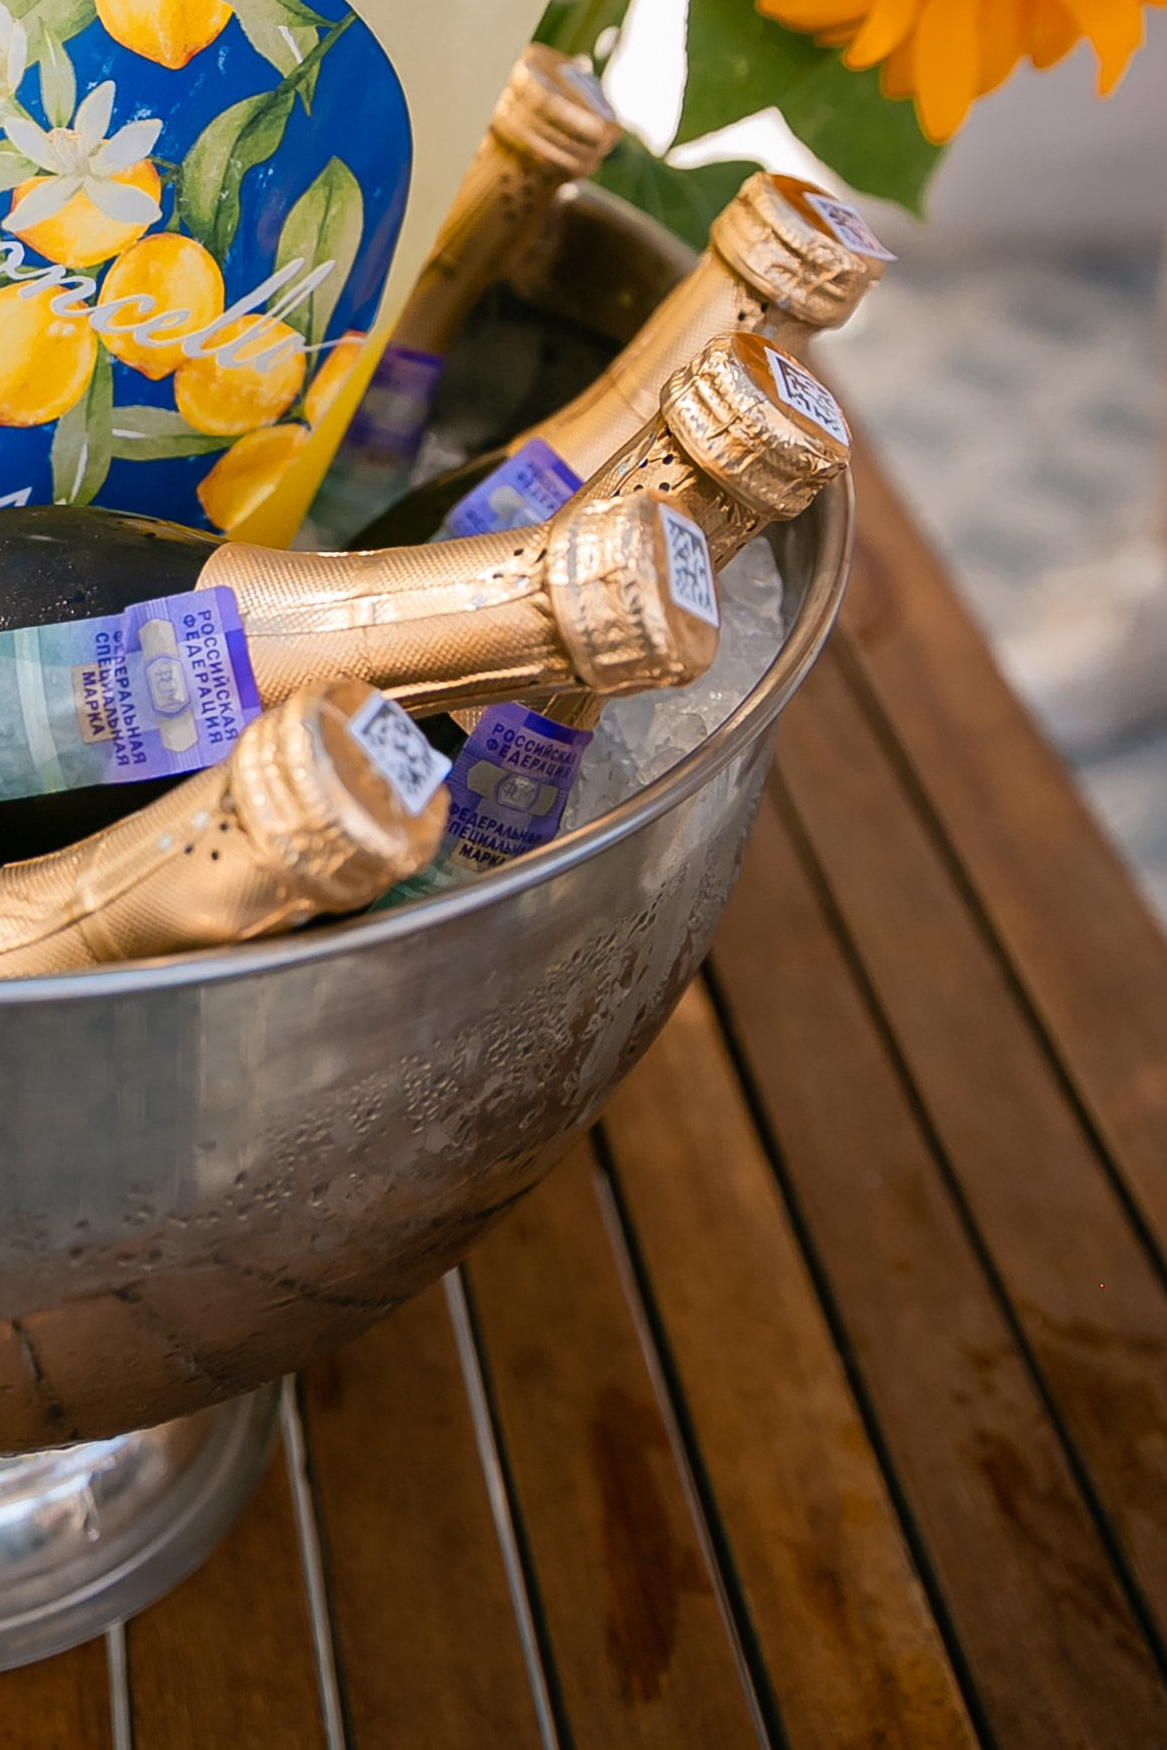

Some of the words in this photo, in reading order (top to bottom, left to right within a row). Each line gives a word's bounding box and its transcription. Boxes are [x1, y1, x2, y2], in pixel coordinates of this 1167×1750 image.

[82, 670, 106, 739] МАРКА
[183, 614, 223, 744] ФЕДЕРАЦИЯ
[198, 610, 239, 741] РОССИЙСКАЯ
